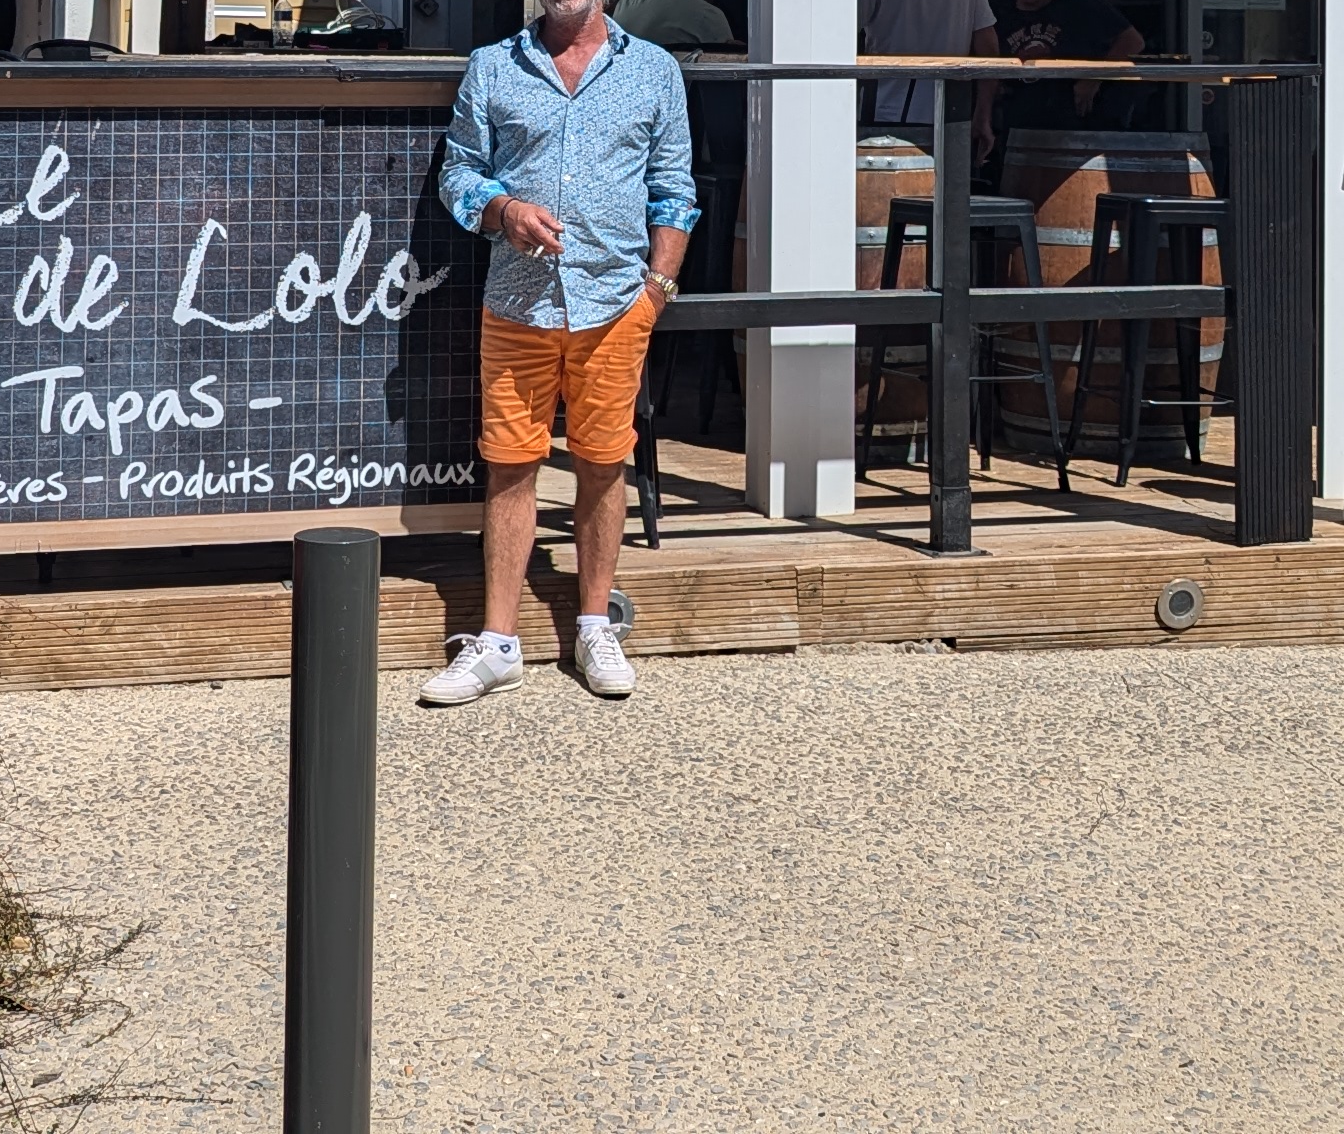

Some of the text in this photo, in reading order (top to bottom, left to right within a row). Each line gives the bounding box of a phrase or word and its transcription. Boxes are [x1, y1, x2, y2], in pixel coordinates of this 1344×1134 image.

[14, 235, 129, 333] de
[172, 211, 451, 333] Lolo
[1, 366, 225, 457] Tapas
[119, 458, 275, 501] Produits
[287, 452, 476, 507] Régionaux
